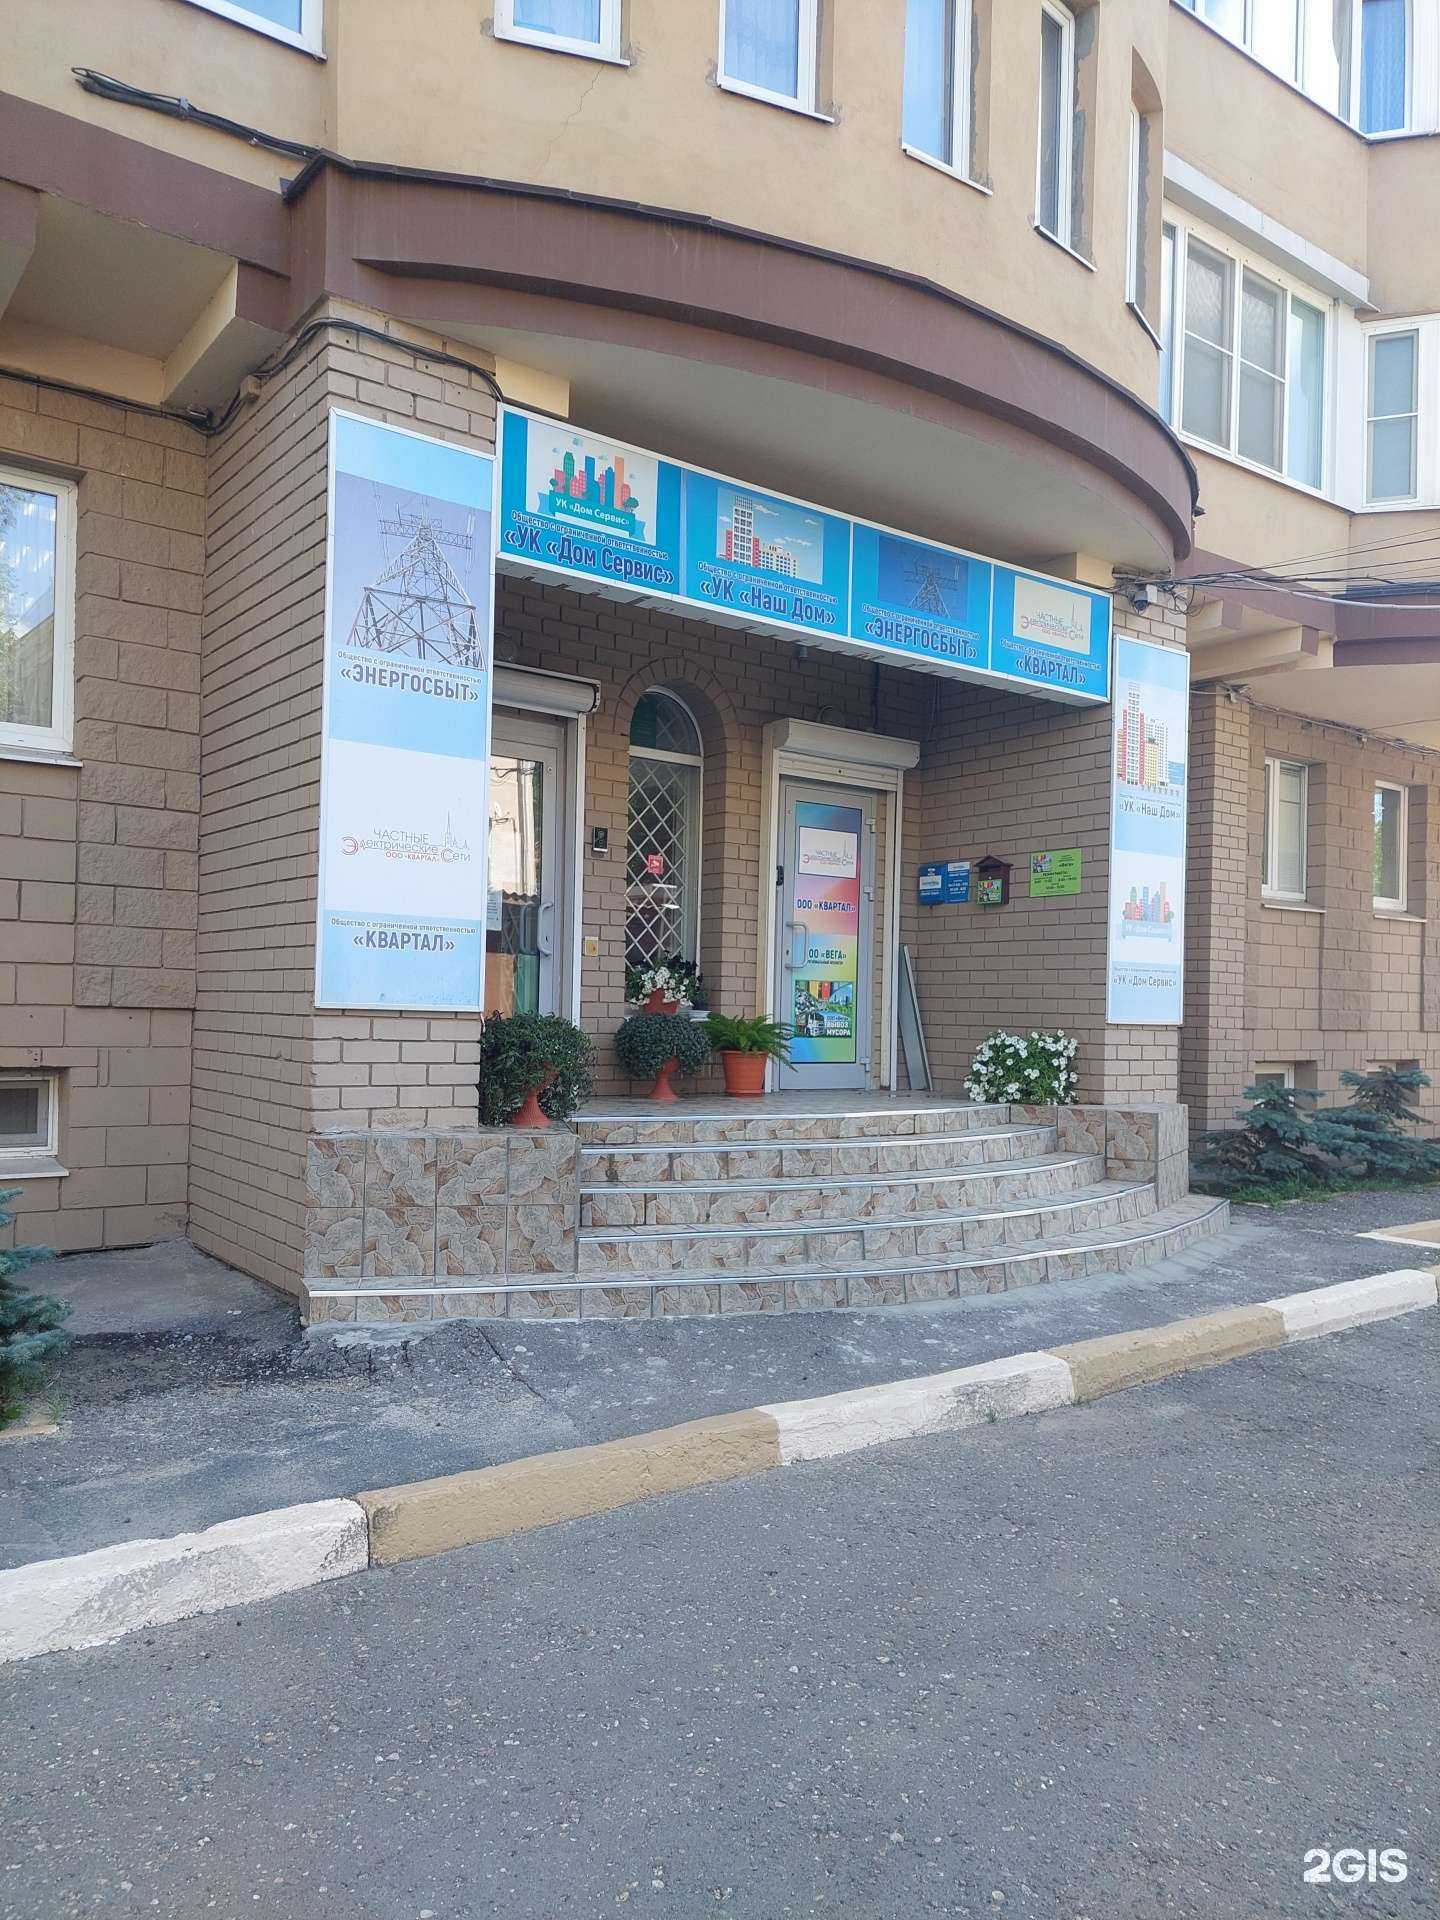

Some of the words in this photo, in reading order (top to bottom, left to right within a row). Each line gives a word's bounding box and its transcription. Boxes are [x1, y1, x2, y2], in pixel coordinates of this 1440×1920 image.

[556, 497, 568, 509] УК
[569, 502, 594, 517] «Дом
[594, 508, 630, 526] Сервис»
[511, 510, 549, 529] Общество
[556, 524, 606, 544] ограниченной
[504, 524, 541, 554] «УК
[546, 535, 597, 568] «Дом
[601, 547, 674, 584] Сервис»
[700, 577, 734, 602] «УК
[740, 586, 787, 614] «Наш
[791, 596, 836, 624] Дом»
[865, 618, 978, 659] «ЭНЕРГОСБЫТ»
[337, 650, 373, 664] Общество
[379, 659, 425, 673] ограниченной
[1016, 655, 1086, 684] «КВАРТАЛ»
[340, 664, 479, 701] «ЭНЕРГОСБЫТ»
[373, 827, 429, 844] ЧАСТНЫЕ
[797, 899, 812, 909] ООО
[814, 901, 856, 912] «КВАРТАЛ»
[331, 918, 366, 927] Общество
[372, 922, 418, 931] ограниченной
[353, 930, 455, 951] «КВАРТАЛ»
